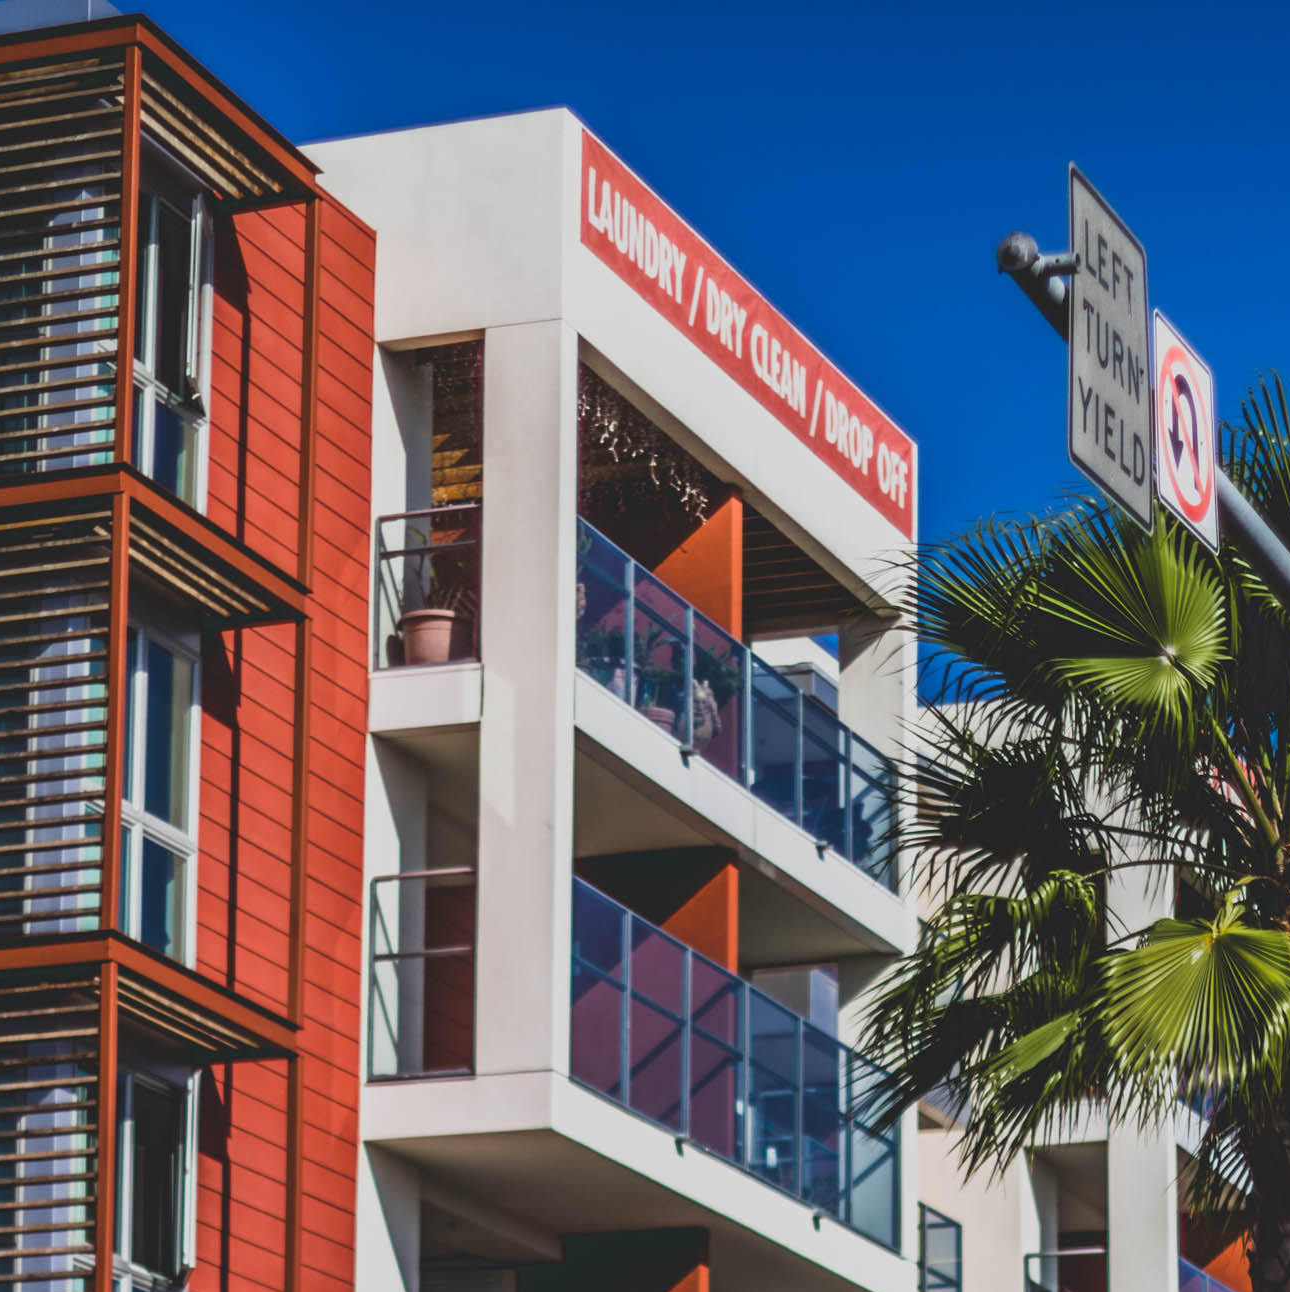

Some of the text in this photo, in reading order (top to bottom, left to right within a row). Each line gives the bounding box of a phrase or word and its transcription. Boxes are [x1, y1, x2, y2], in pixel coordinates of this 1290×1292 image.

[1084, 219, 1134, 313] LEFT
[588, 166, 909, 509] LAUNDRY / DRY CLEAN / DROP OFF
[1083, 296, 1141, 404] TURN
[1078, 376, 1146, 487] YIELD
